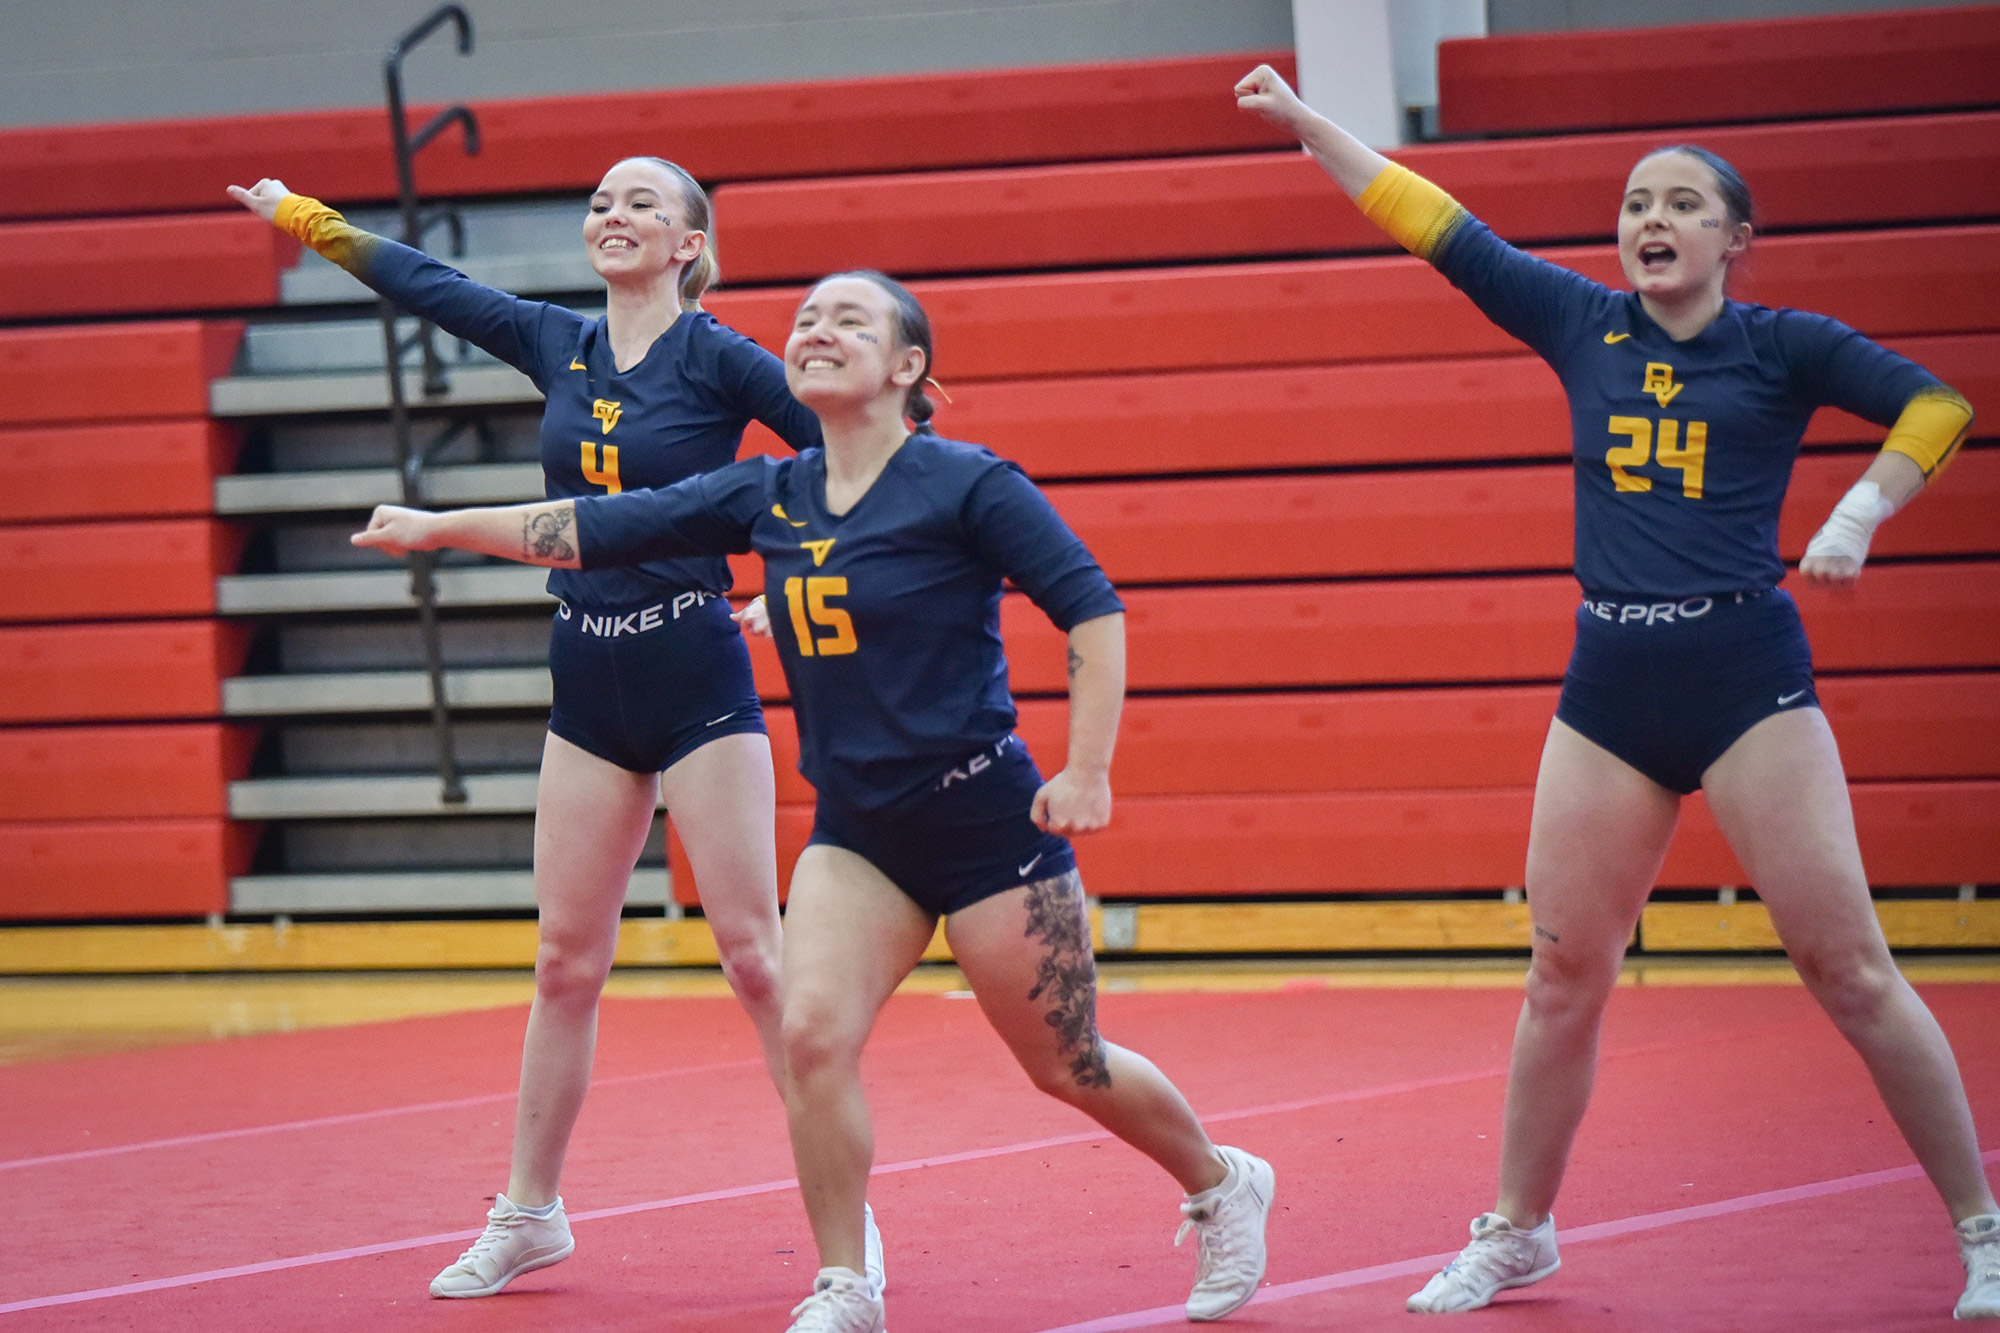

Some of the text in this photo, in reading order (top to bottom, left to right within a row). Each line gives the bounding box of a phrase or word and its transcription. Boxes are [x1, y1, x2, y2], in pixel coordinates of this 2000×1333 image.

[580, 441, 623, 495] 4
[1605, 415, 1708, 499] 24
[581, 603, 664, 637] NIKE
[784, 576, 858, 657] 15
[1618, 596, 1713, 626] PRO
